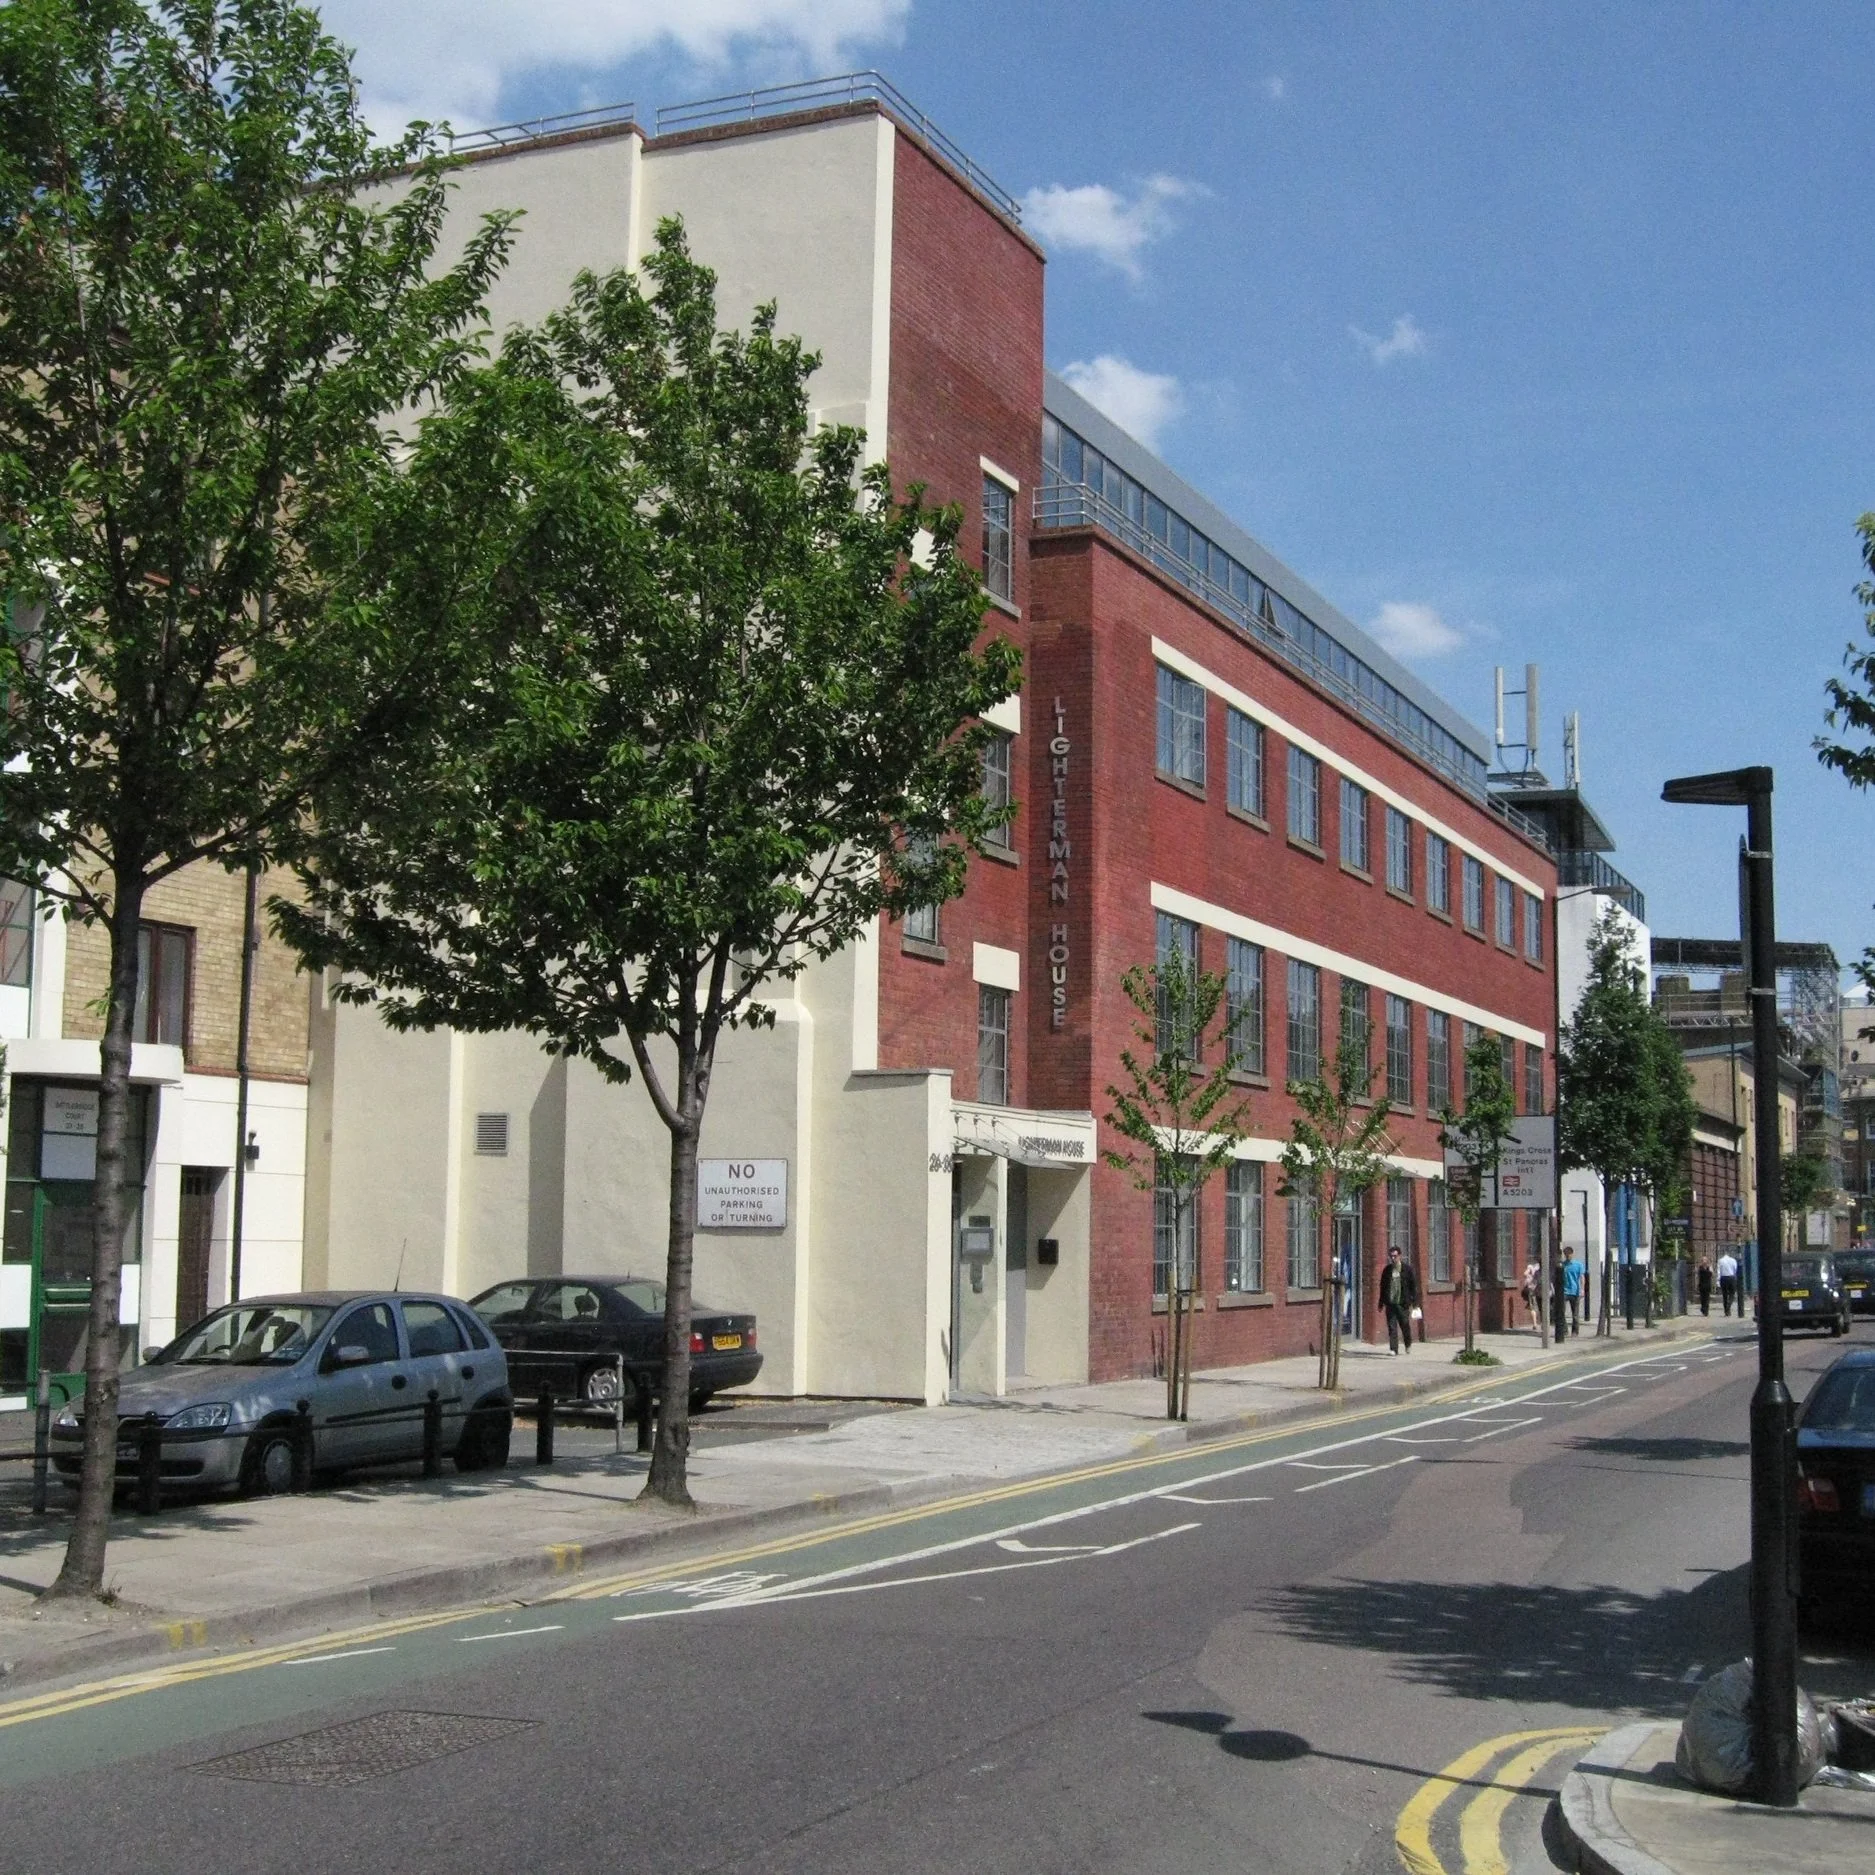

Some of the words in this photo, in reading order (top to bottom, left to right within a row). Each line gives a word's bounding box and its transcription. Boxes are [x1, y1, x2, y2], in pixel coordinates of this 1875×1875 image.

[1050, 696, 1071, 900] LIGHTERMAN
[1049, 924, 1070, 1026] HOUSE
[1527, 1146, 1552, 1154] Cross
[1503, 1157, 1513, 1165] St
[1515, 1157, 1549, 1165] Pancras
[728, 1164, 756, 1179] NO
[704, 1186, 779, 1196] UNAUTHORISED
[1502, 1188, 1533, 1197] A5203
[720, 1200, 764, 1209] PARKING
[711, 1213, 725, 1222] OR
[729, 1214, 773, 1222] TURNING
